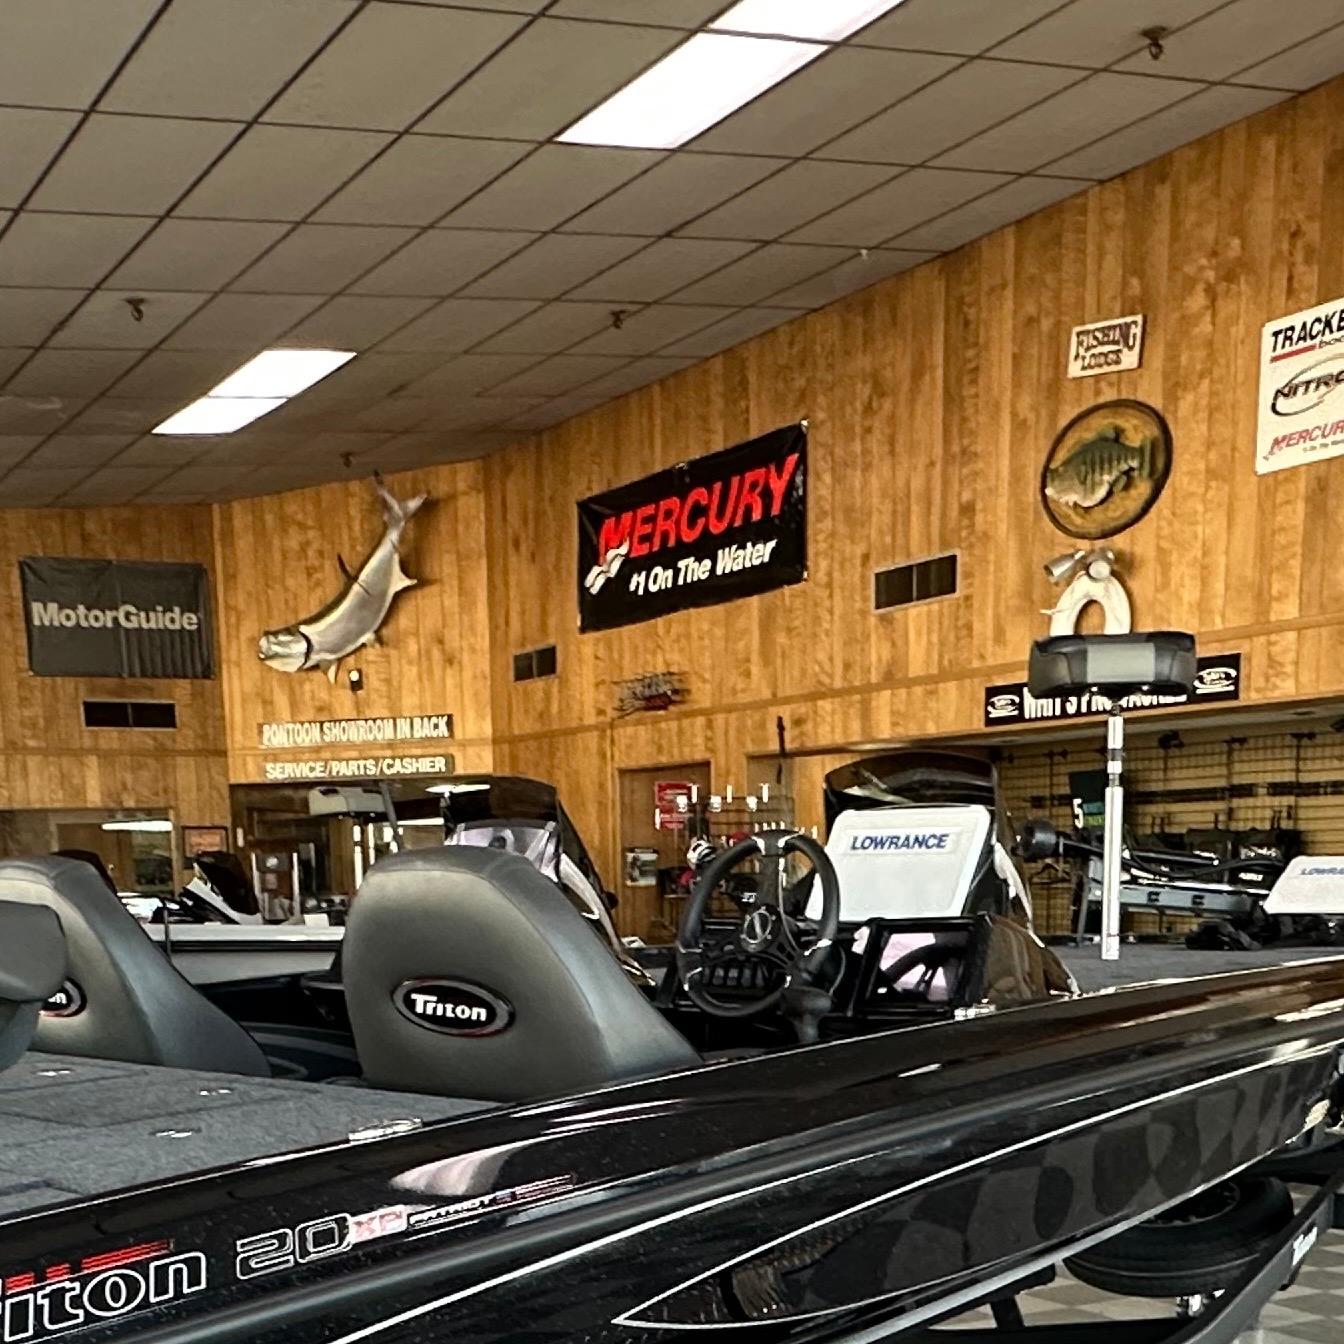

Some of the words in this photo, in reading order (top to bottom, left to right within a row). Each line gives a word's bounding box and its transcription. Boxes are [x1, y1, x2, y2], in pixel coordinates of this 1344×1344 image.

[1074, 320, 1138, 361] FISHING
[598, 452, 800, 566] MERCURY
[648, 565, 674, 593] On
[677, 556, 712, 586] The
[716, 538, 778, 576] Water
[31, 601, 199, 631] MotorGuide
[262, 722, 322, 746] PONTOON
[322, 716, 395, 742] SHOWROOM
[396, 717, 411, 739] IN
[413, 715, 449, 738] BACK
[265, 756, 447, 779] SERVICE/PARTS/CASHIER
[850, 833, 951, 851] LOWRANCE
[410, 992, 488, 1022] Triton
